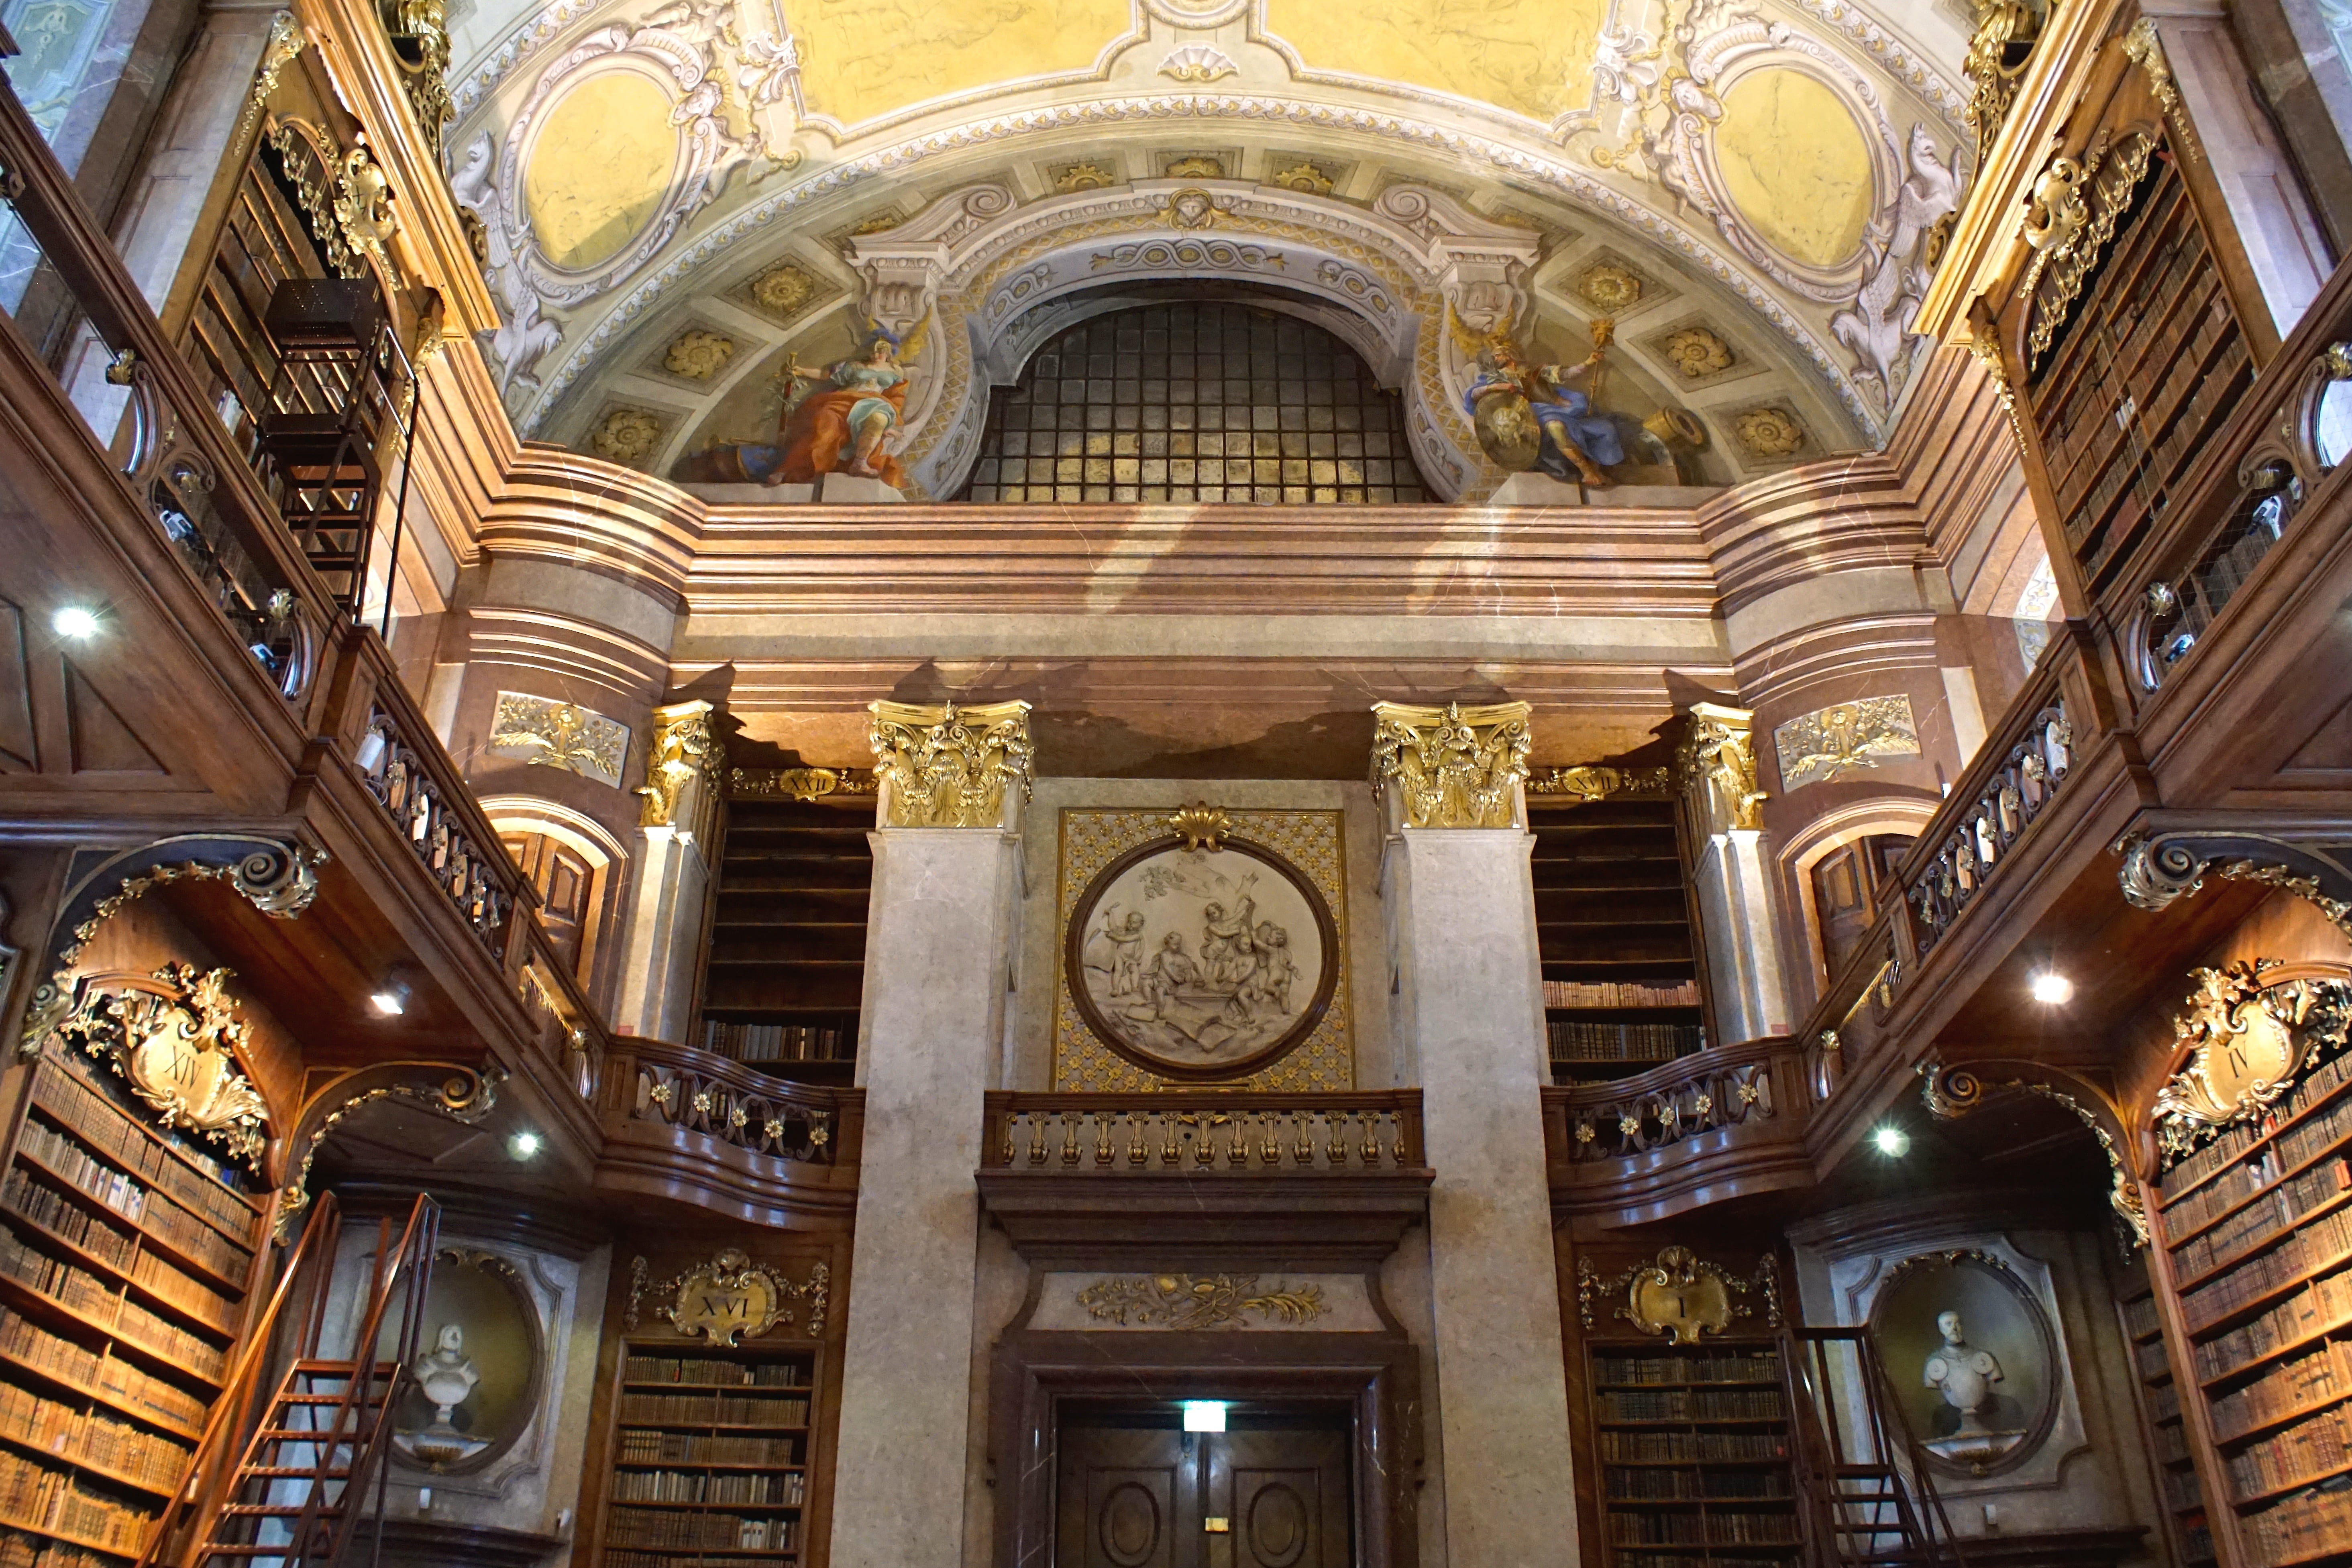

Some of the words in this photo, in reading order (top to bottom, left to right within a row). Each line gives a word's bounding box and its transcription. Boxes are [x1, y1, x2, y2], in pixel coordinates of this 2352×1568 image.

[790, 778, 826, 791] XXII
[1573, 776, 1611, 790] XVII
[164, 1045, 202, 1089] XIV
[2228, 1040, 2248, 1079] IV
[1678, 1297, 1686, 1318] I
